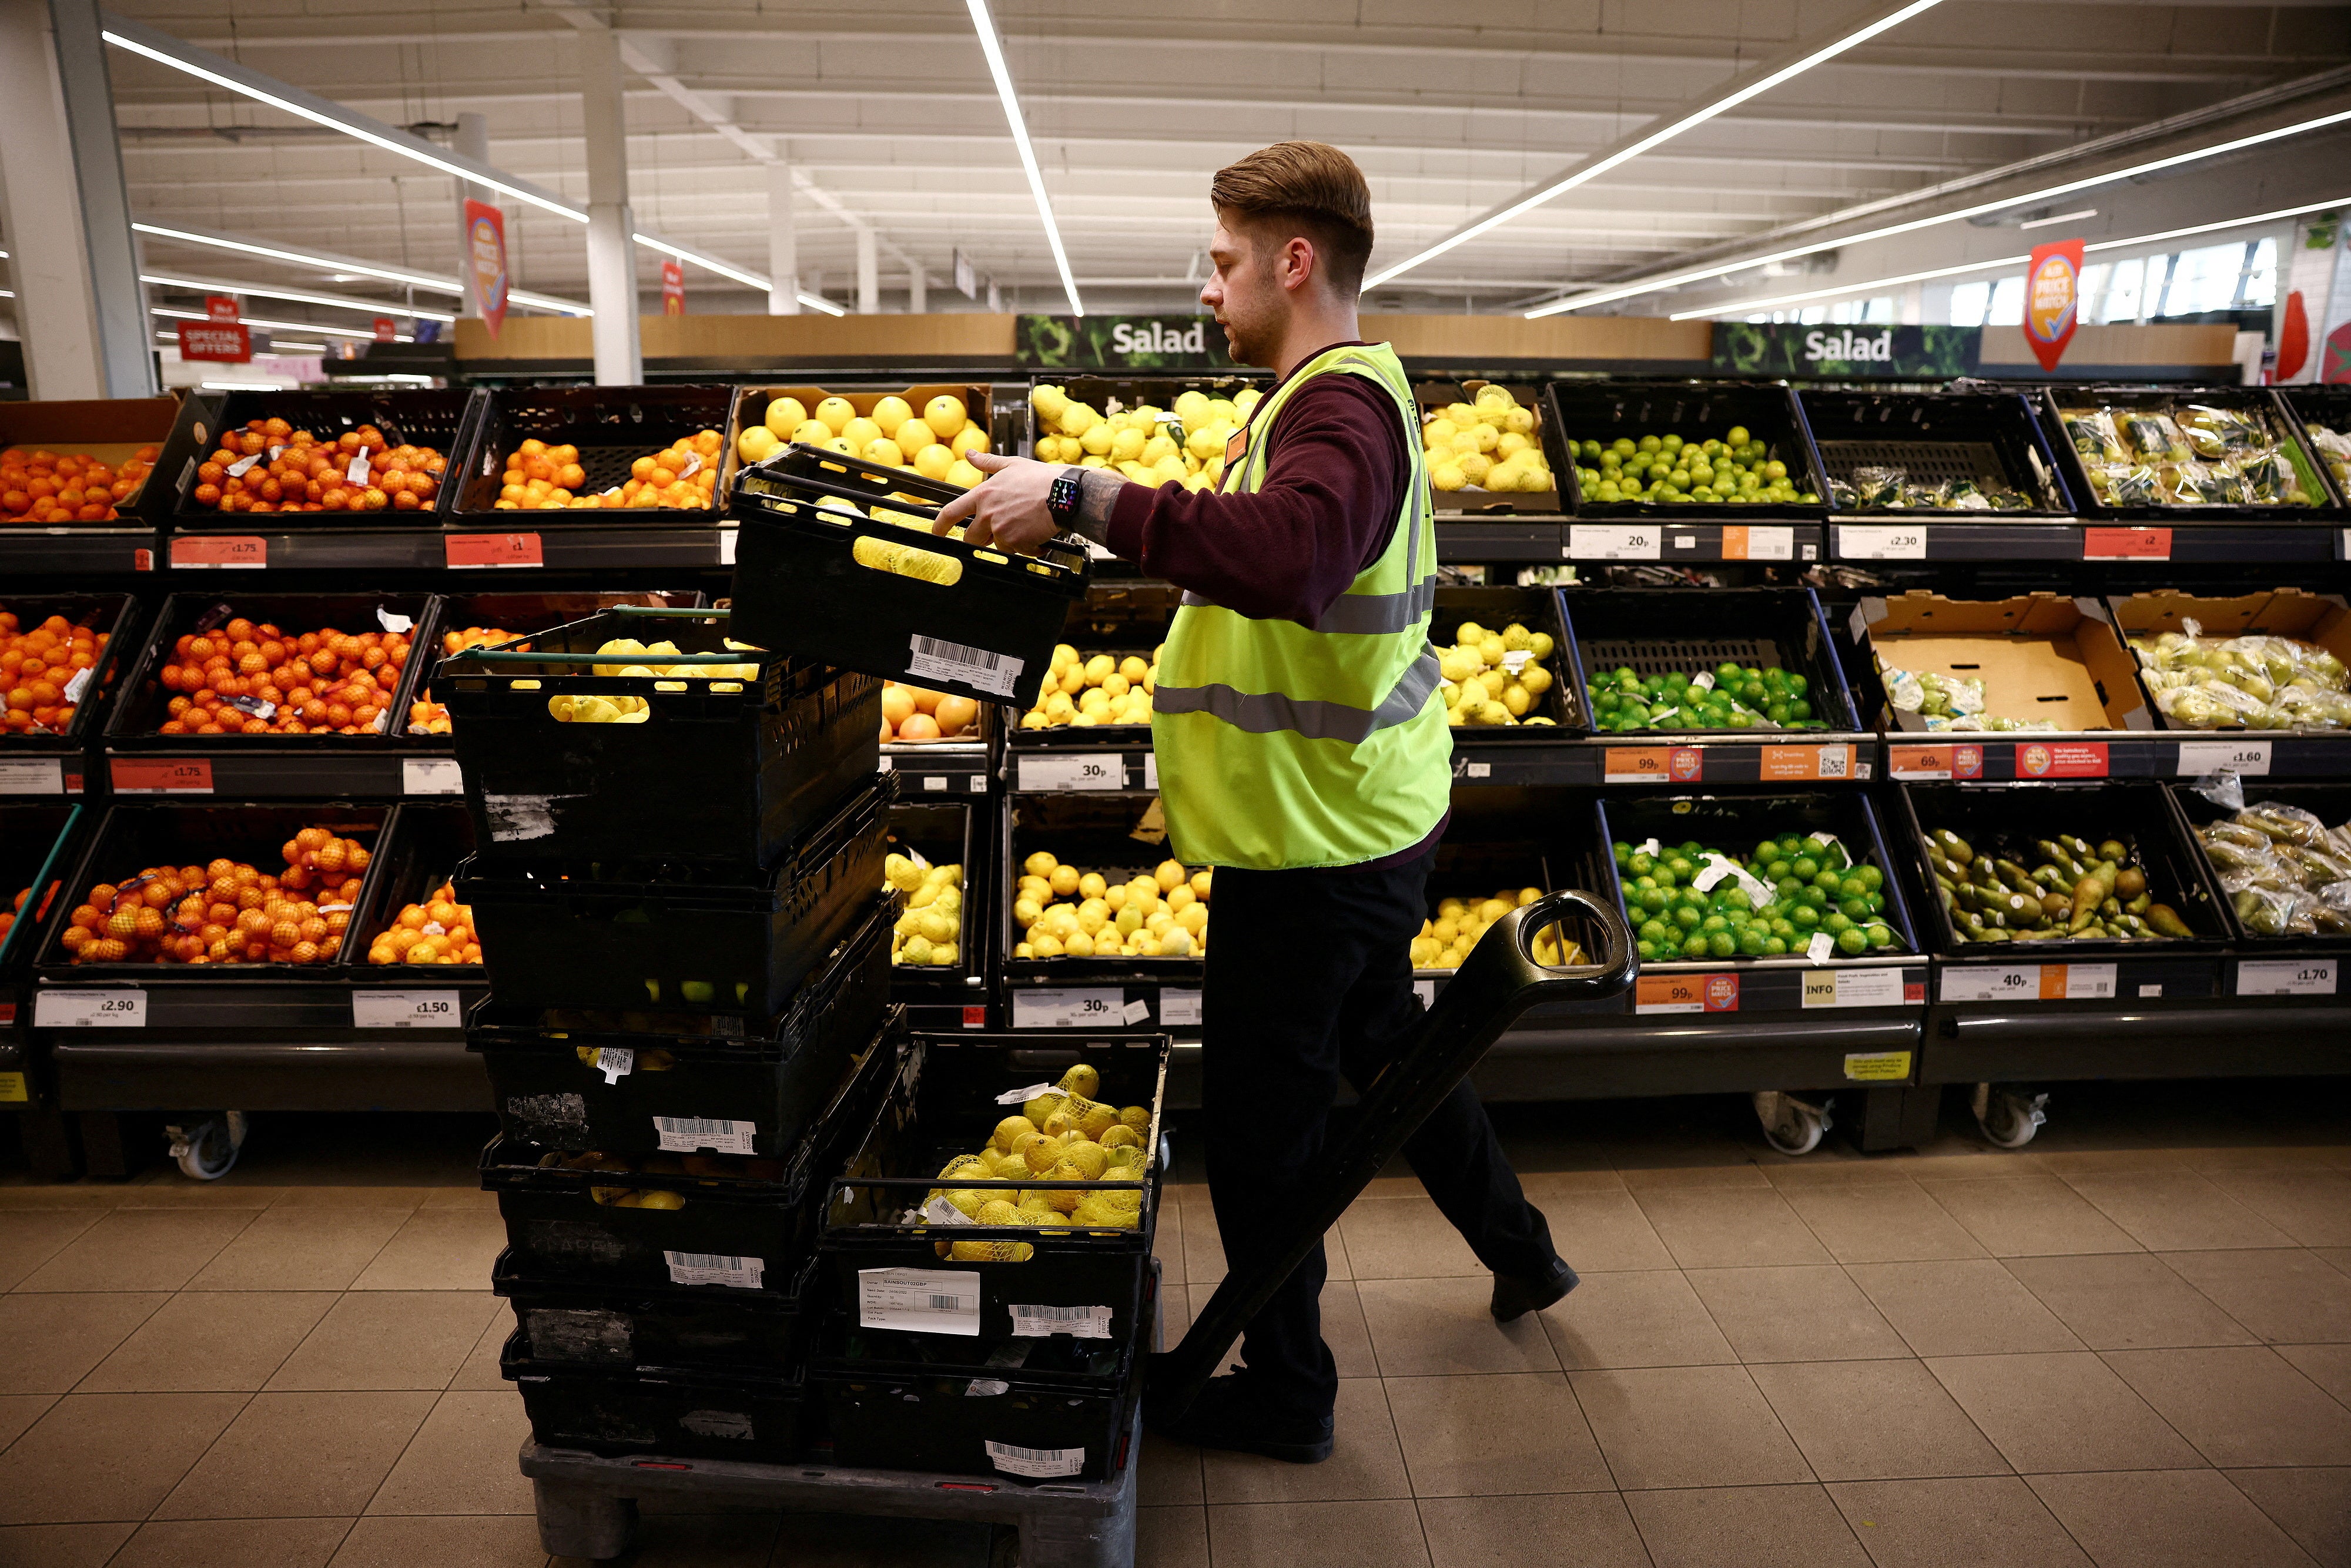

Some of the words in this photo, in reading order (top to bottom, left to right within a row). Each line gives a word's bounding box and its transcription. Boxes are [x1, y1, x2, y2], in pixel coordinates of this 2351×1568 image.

[2035, 276, 2071, 294] PRICE
[2034, 294, 2069, 310] MATCH
[185, 329, 242, 343] SPECIAL
[1113, 321, 1205, 353] Salad
[189, 343, 242, 354] OFFERS
[1805, 329, 1892, 361] Salad
[1629, 536, 1649, 547] 20p
[1891, 537, 1917, 545] £2.30
[232, 544, 256, 552] £1.75
[1005, 669, 1014, 691] SUNDAY
[1921, 756, 1940, 767] 69p
[2233, 752, 2261, 762] £1.60
[1639, 759, 1659, 770] 99p
[175, 766, 200, 776] £1.75
[1083, 765, 1106, 777] 30p
[2298, 969, 2327, 980] £1.70
[2004, 974, 2027, 987] 40p
[1672, 987, 1693, 1000] 99p
[1807, 985, 1833, 994] INFO
[102, 1001, 133, 1011] £2.90
[417, 1002, 448, 1013] £1.50
[1083, 1000, 1108, 1012] 30p
